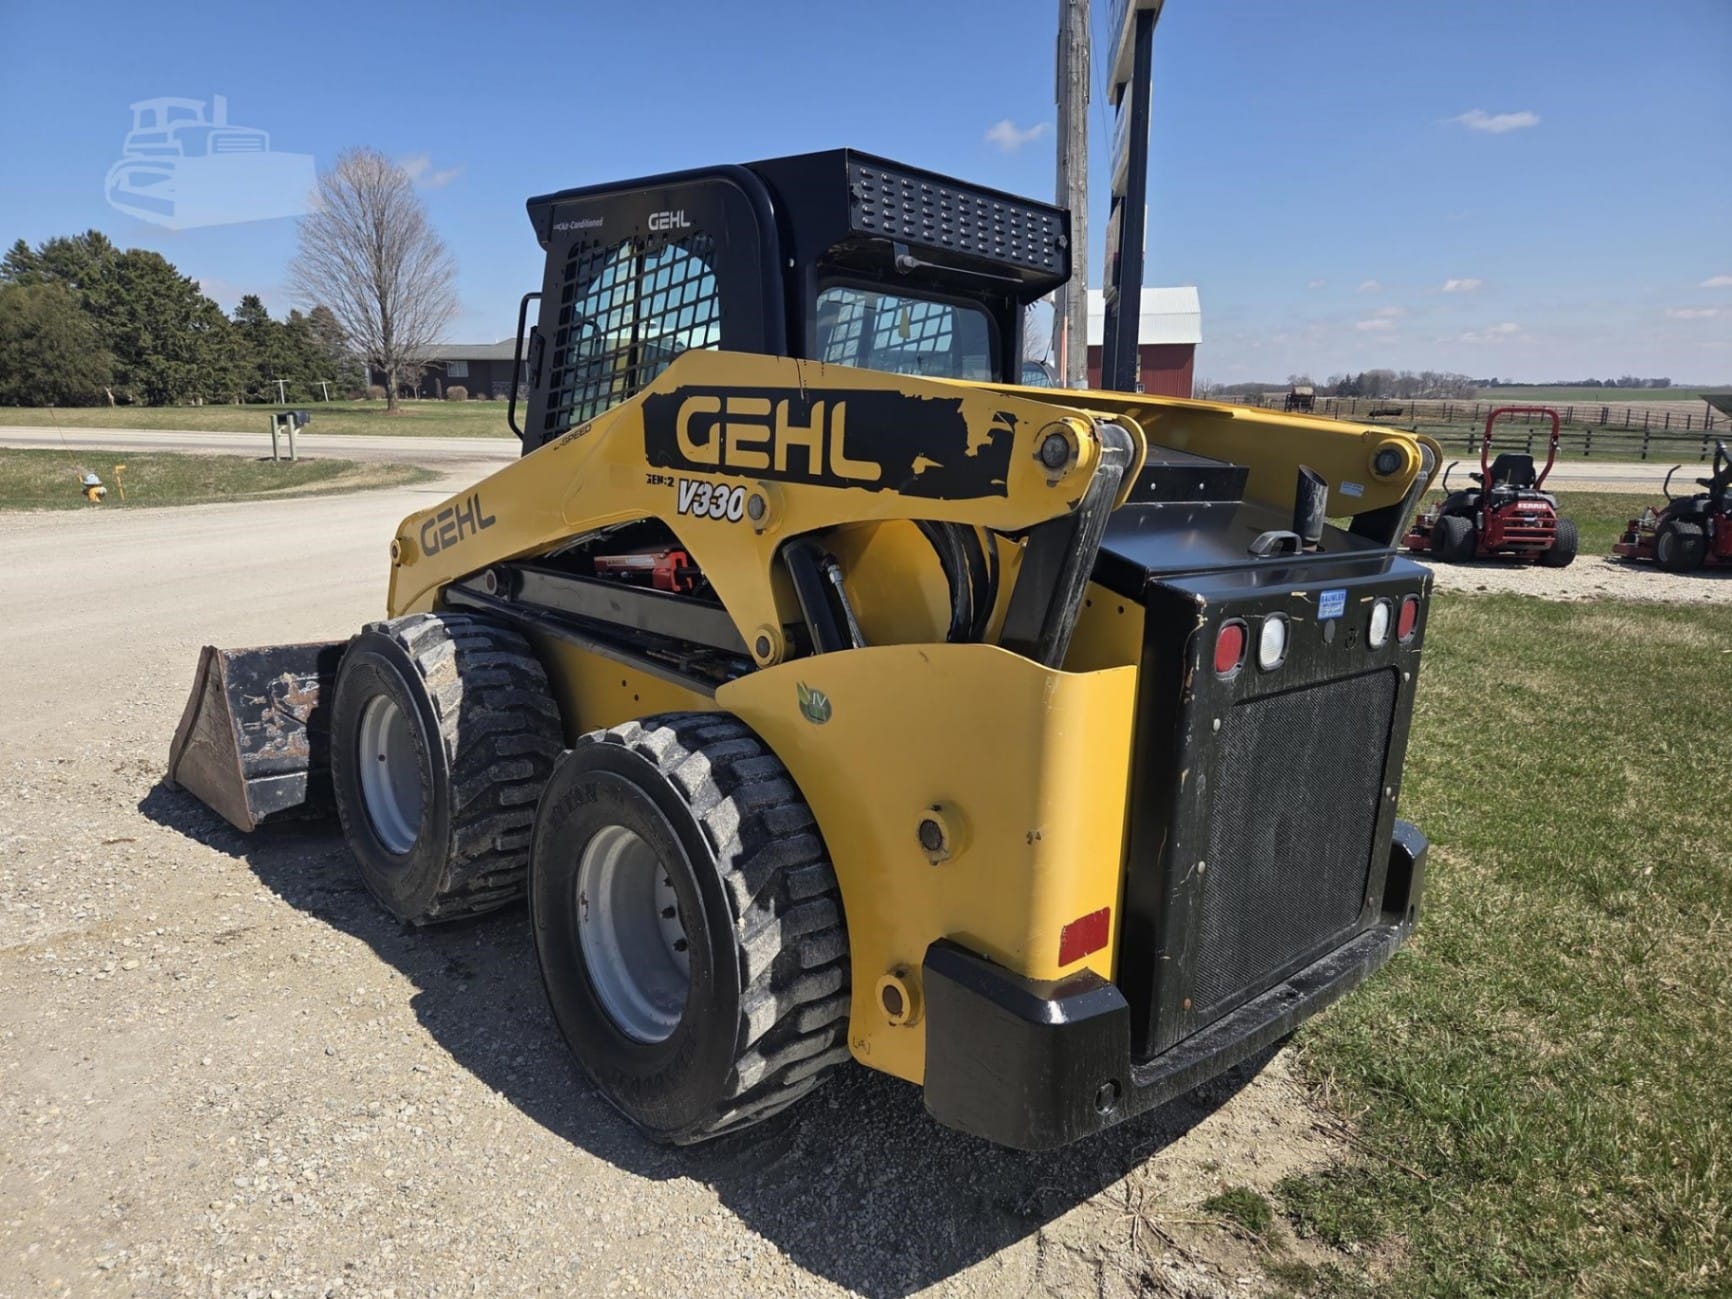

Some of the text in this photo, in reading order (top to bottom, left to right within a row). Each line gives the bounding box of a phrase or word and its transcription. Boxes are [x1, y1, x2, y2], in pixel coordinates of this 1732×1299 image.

[648, 209, 691, 231] GEHL
[675, 395, 882, 481] GEHL
[420, 492, 496, 557] GEHL
[677, 478, 748, 523] V330
